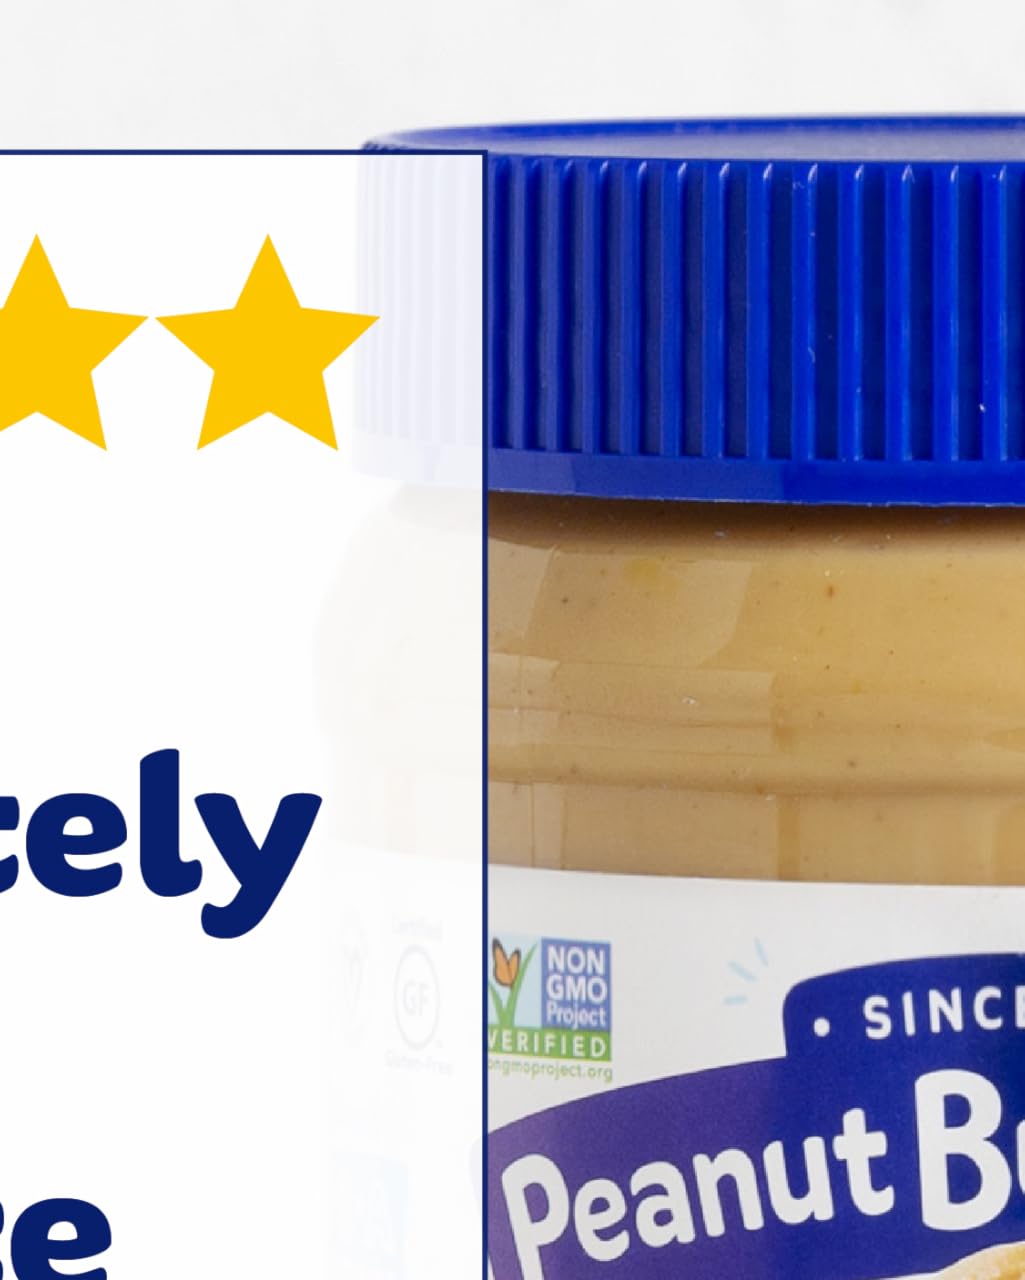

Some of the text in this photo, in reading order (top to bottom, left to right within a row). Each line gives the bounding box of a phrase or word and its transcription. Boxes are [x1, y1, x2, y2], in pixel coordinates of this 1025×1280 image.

[547, 945, 605, 975] NON
[546, 973, 608, 1005] GMO
[546, 1001, 606, 1029] Project
[487, 1058, 613, 1083] ongmoproject.org
[914, 1068, 1025, 1231] B
